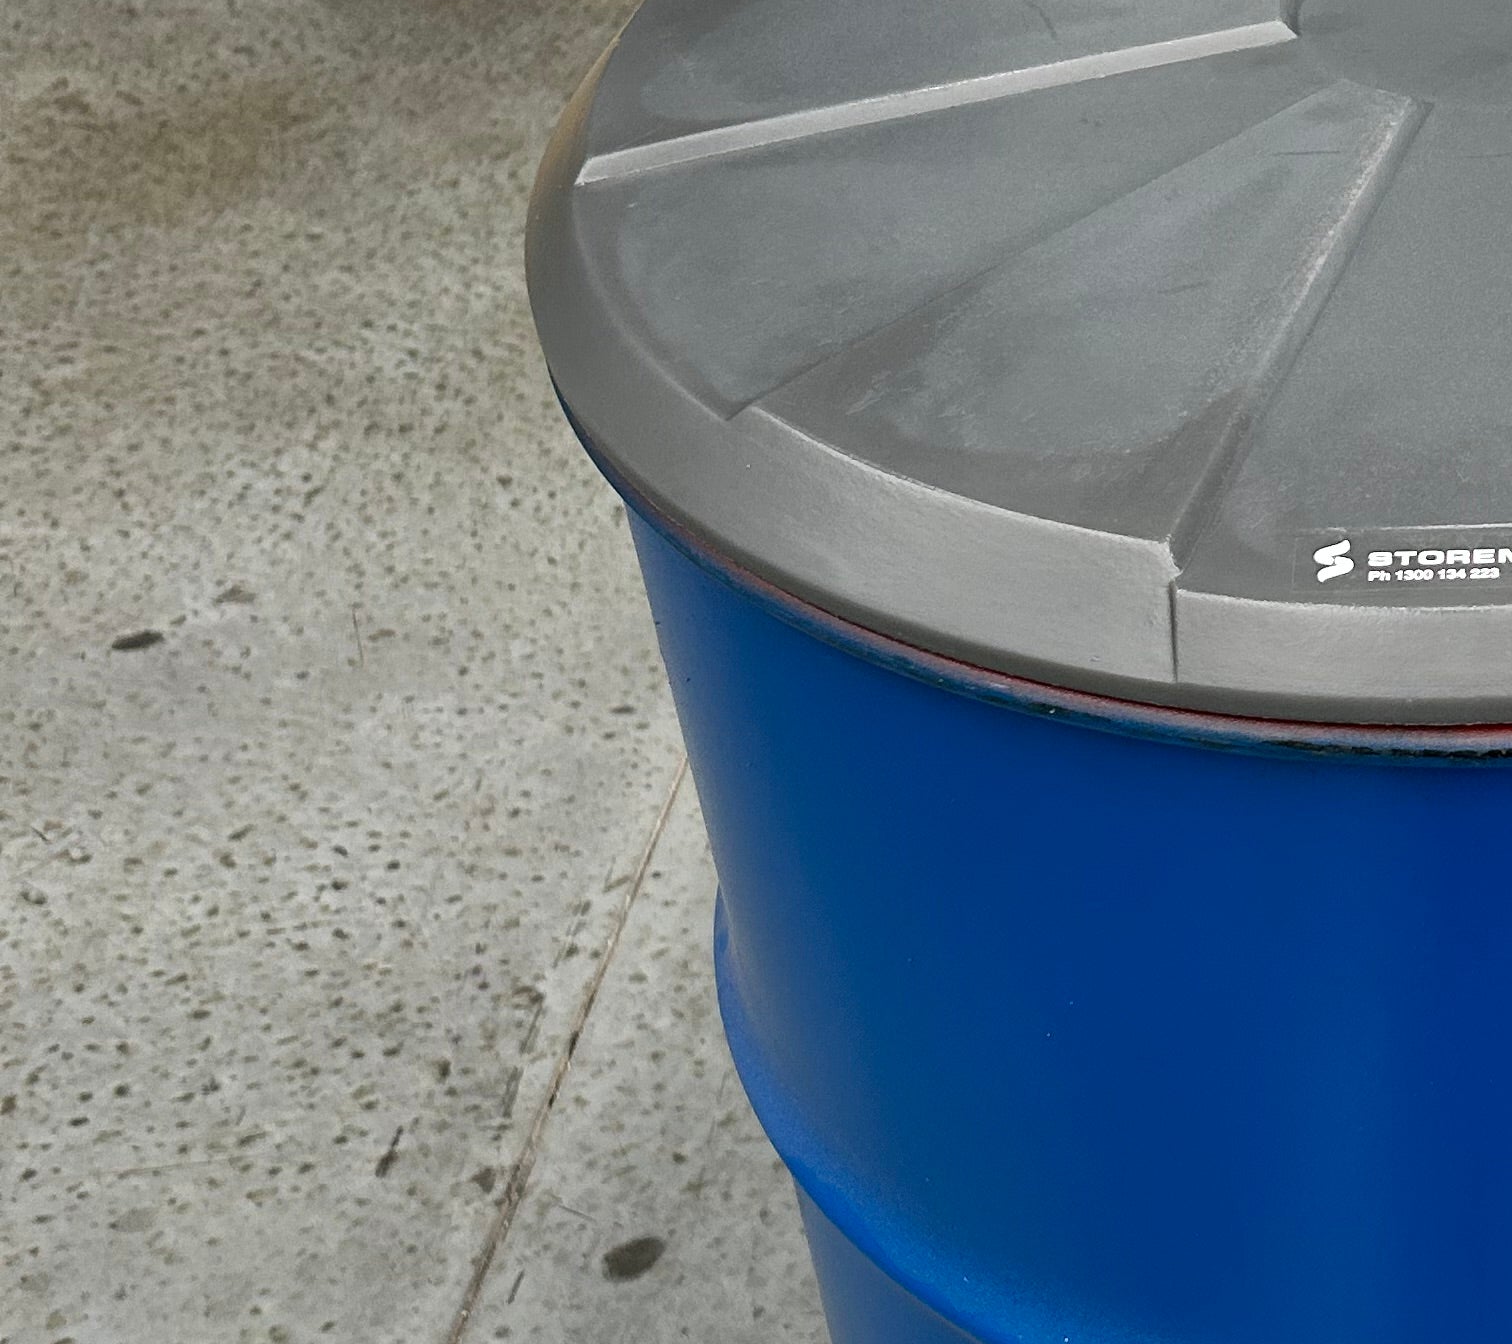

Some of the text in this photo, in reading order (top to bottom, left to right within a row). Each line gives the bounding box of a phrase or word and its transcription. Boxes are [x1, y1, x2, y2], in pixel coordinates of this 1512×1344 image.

[1368, 570, 1391, 582] Ph
[1395, 568, 1434, 581] 1300
[1437, 568, 1467, 580] 134
[1469, 567, 1500, 579] 223
